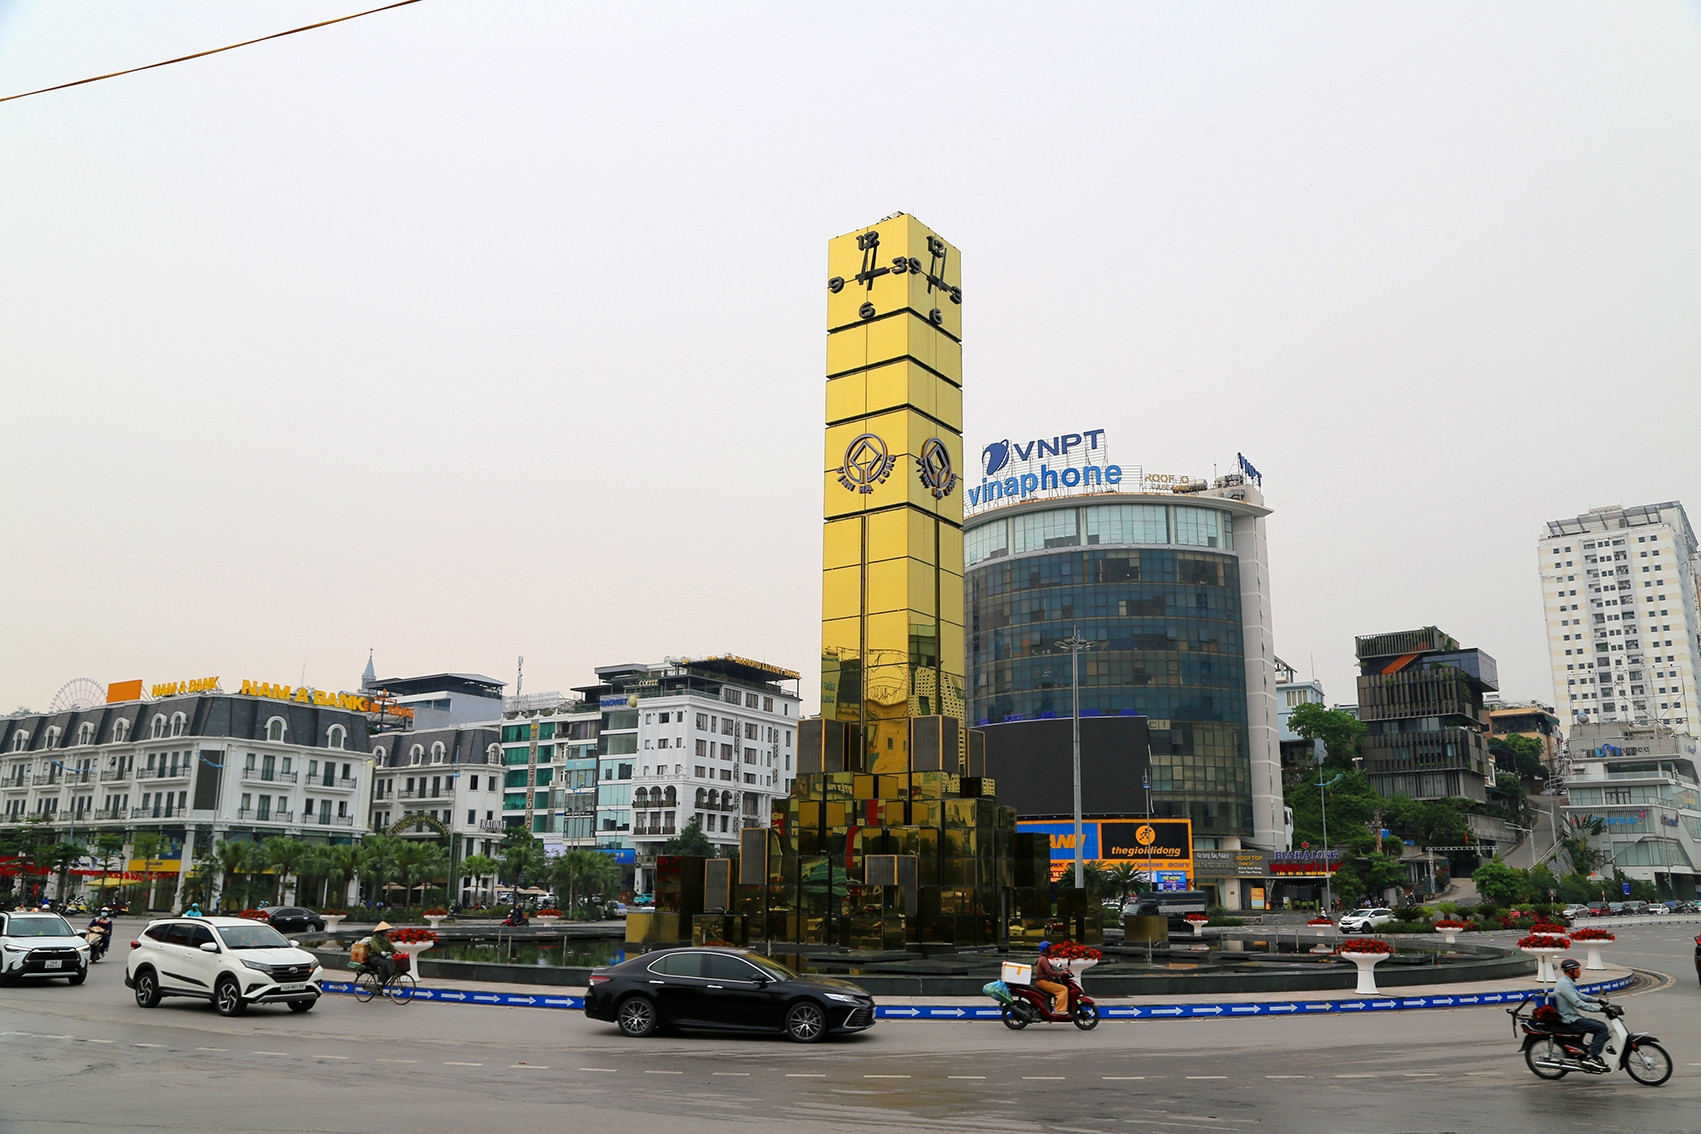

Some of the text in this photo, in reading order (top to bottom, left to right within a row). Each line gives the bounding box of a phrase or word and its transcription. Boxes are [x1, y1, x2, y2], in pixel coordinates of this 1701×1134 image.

[856, 231, 880, 251] 12
[926, 236, 944, 258] 12
[892, 256, 907, 275] 3
[909, 257, 921, 274] 9
[828, 276, 844, 294] 9
[949, 286, 962, 304] 3
[859, 301, 875, 319] 6
[929, 308, 943, 325] 6
[1013, 429, 1104, 461] VNPT
[877, 454, 896, 484] LONG
[1238, 452, 1262, 487] VNPT
[967, 464, 1122, 507] vinaphone
[152, 681, 177, 697] NAM
[188, 676, 219, 693] BANK
[242, 679, 291, 701] NAM
[313, 689, 365, 712] BANK
[481, 819, 507, 832] KATINAT
[1111, 846, 1181, 857] thegioididong
